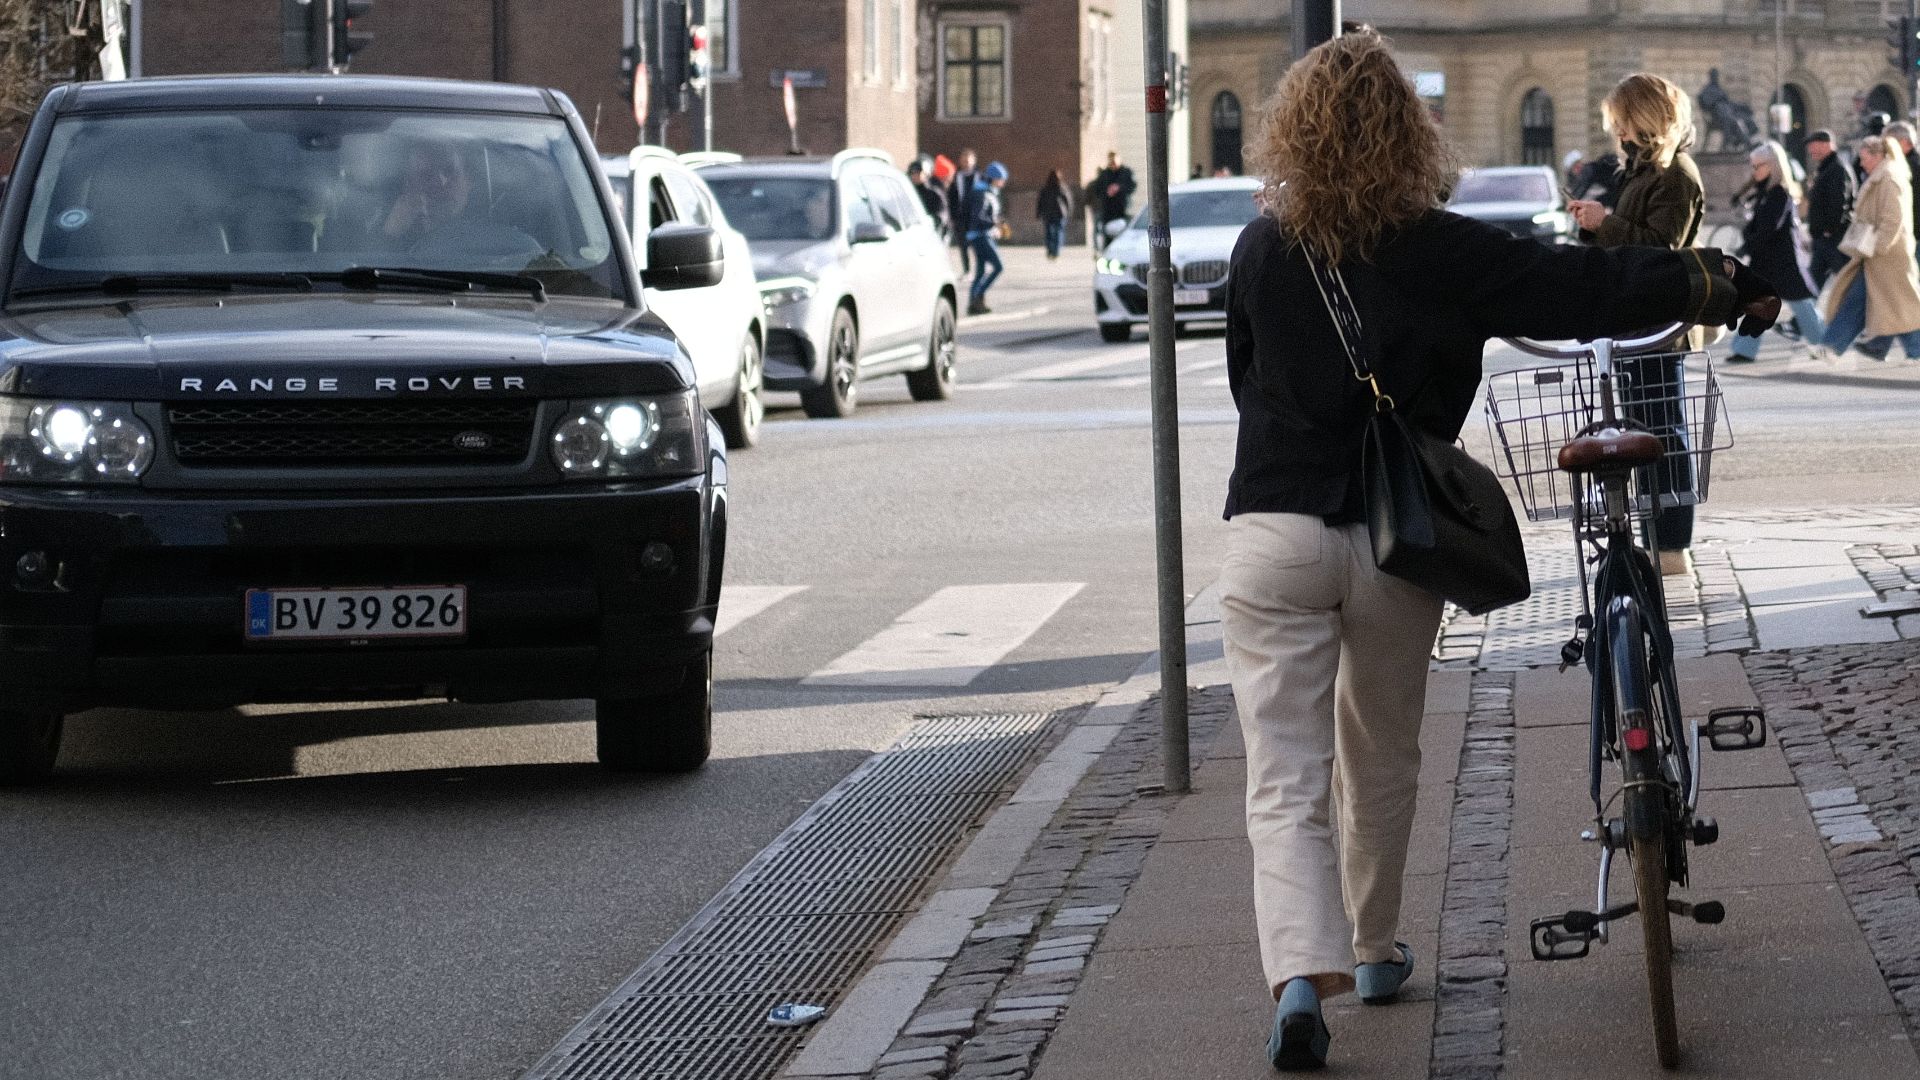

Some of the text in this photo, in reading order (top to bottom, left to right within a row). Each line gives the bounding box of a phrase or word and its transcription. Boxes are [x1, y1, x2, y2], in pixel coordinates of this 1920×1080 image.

[180, 377, 525, 391] RANGE ROVER
[275, 593, 460, 630] BV 39 826
[251, 619, 266, 629] DK
